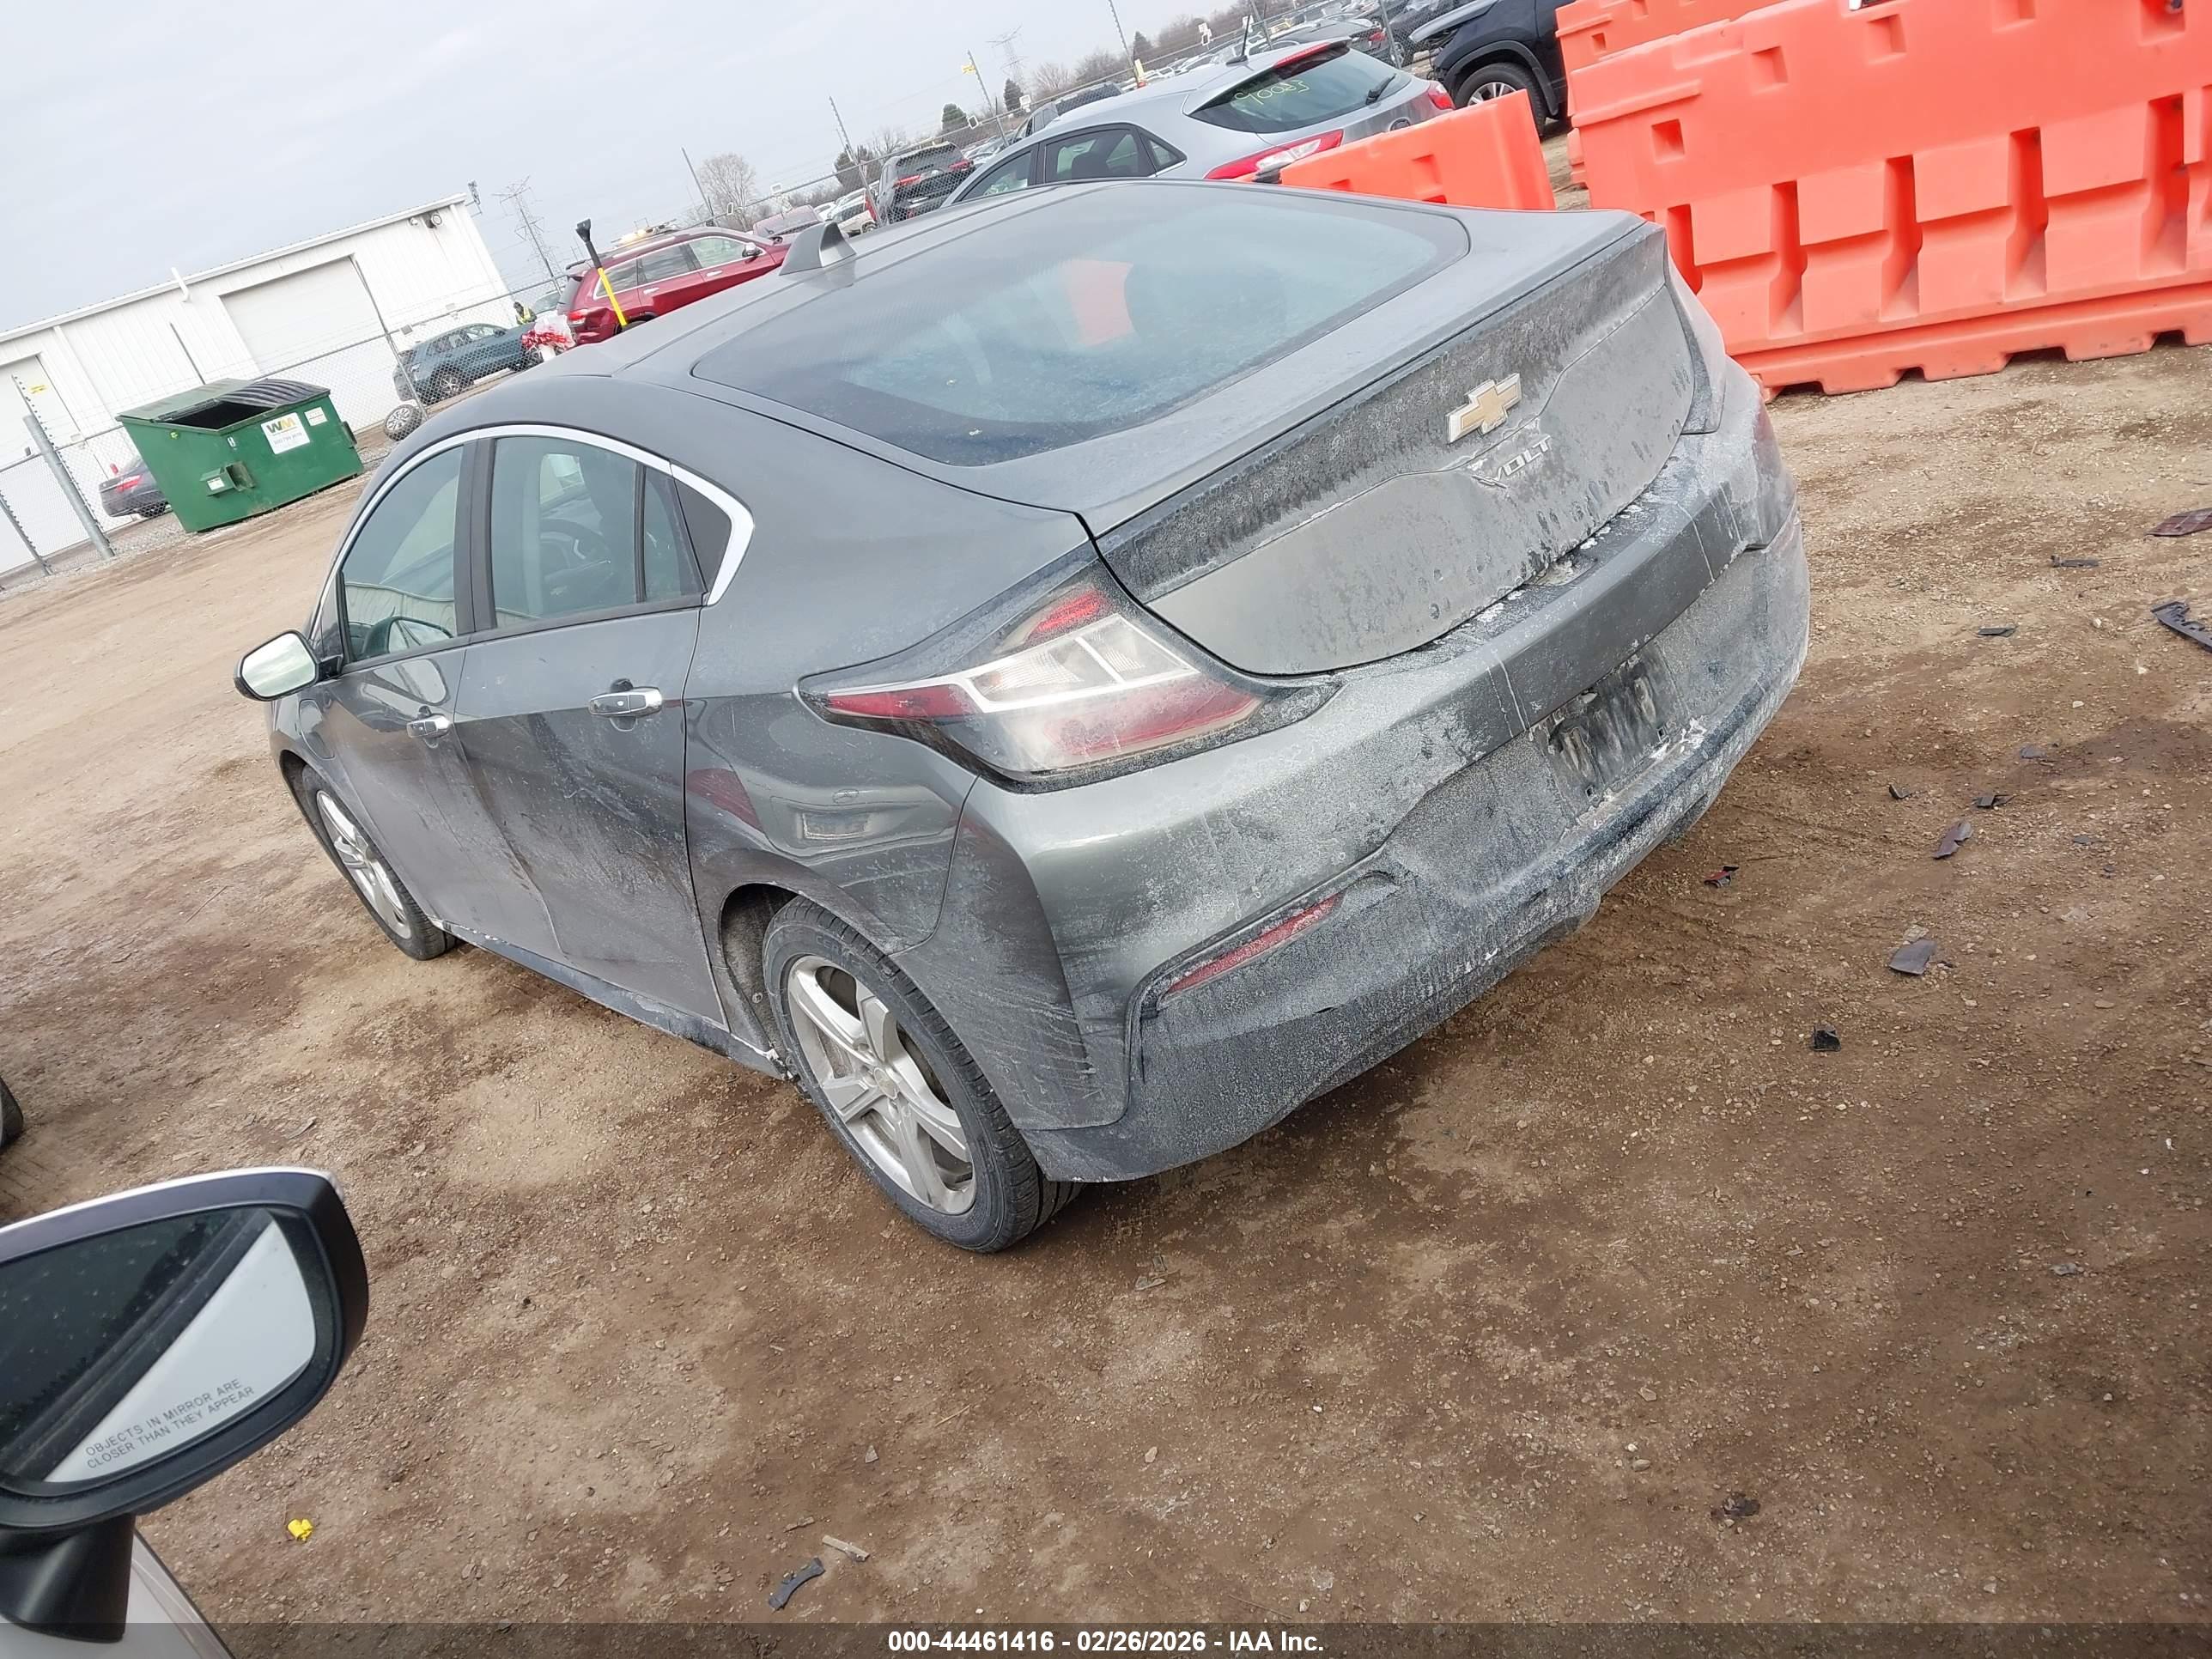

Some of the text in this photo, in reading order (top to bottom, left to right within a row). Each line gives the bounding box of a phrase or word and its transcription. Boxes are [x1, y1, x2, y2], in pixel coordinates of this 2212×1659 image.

[266, 416, 296, 434] WM
[1472, 434, 1551, 488] VOLT
[86, 1379, 241, 1455] OBJECTS IN MIRROR ARE
[87, 1386, 254, 1468] CLOSER THAN THEY APPEAR
